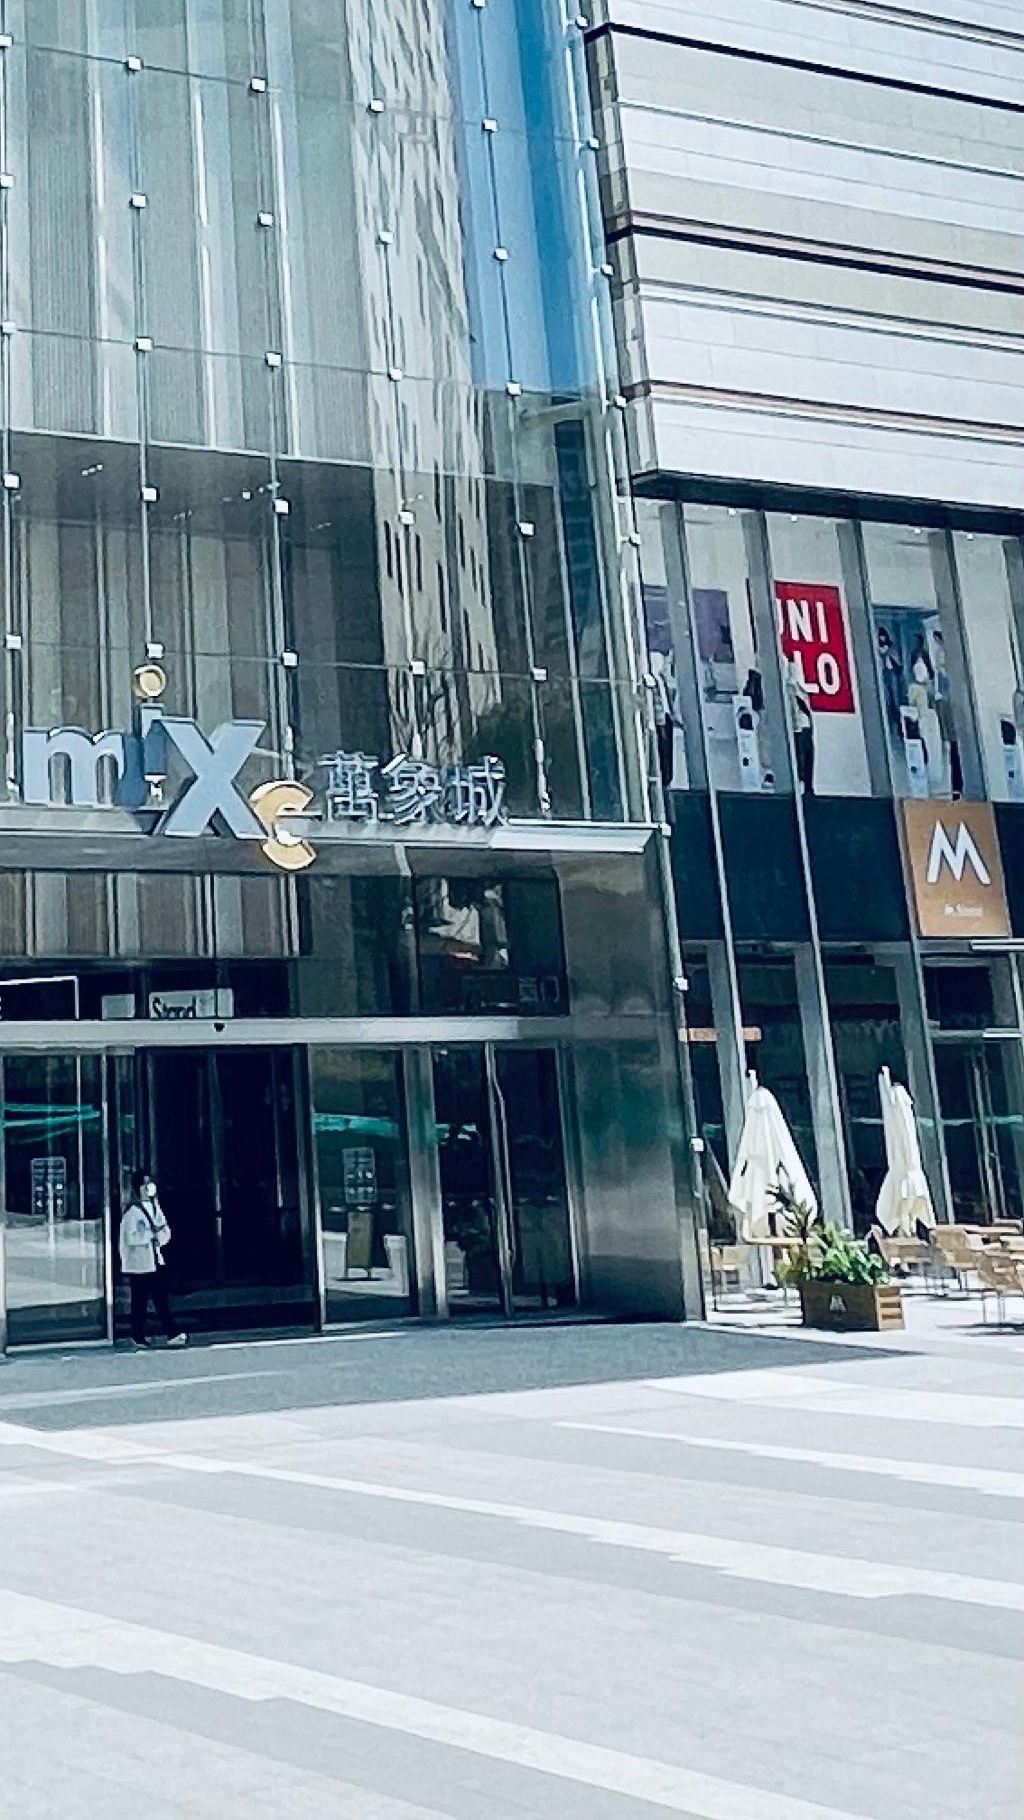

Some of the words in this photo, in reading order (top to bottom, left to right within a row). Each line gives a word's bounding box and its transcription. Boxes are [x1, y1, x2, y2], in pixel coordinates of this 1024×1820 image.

[790, 650, 841, 695] LO
[316, 750, 508, 827] 萬象城
